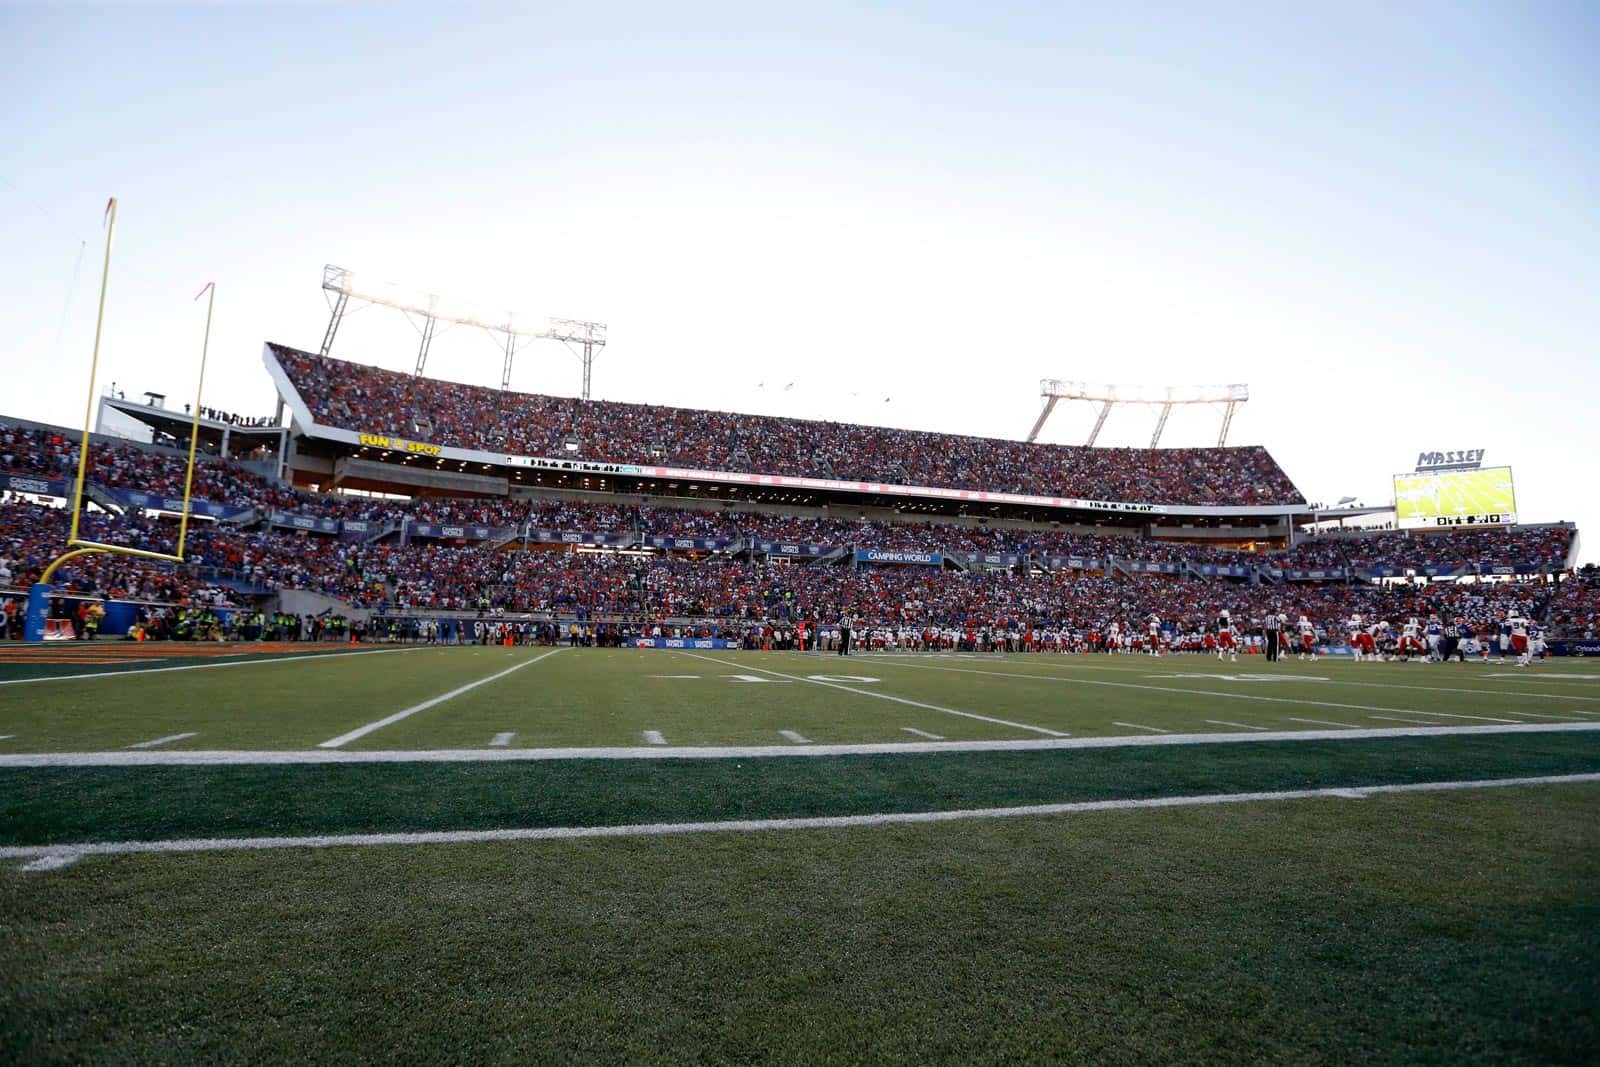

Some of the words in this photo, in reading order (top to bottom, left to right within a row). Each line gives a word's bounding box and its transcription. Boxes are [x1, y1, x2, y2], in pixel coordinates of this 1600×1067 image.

[359, 433, 389, 447] FUN
[407, 442, 441, 456] SPOT
[1417, 449, 1485, 465] MASSEY
[868, 552, 902, 561] CAMPING
[905, 554, 931, 563] WORLD
